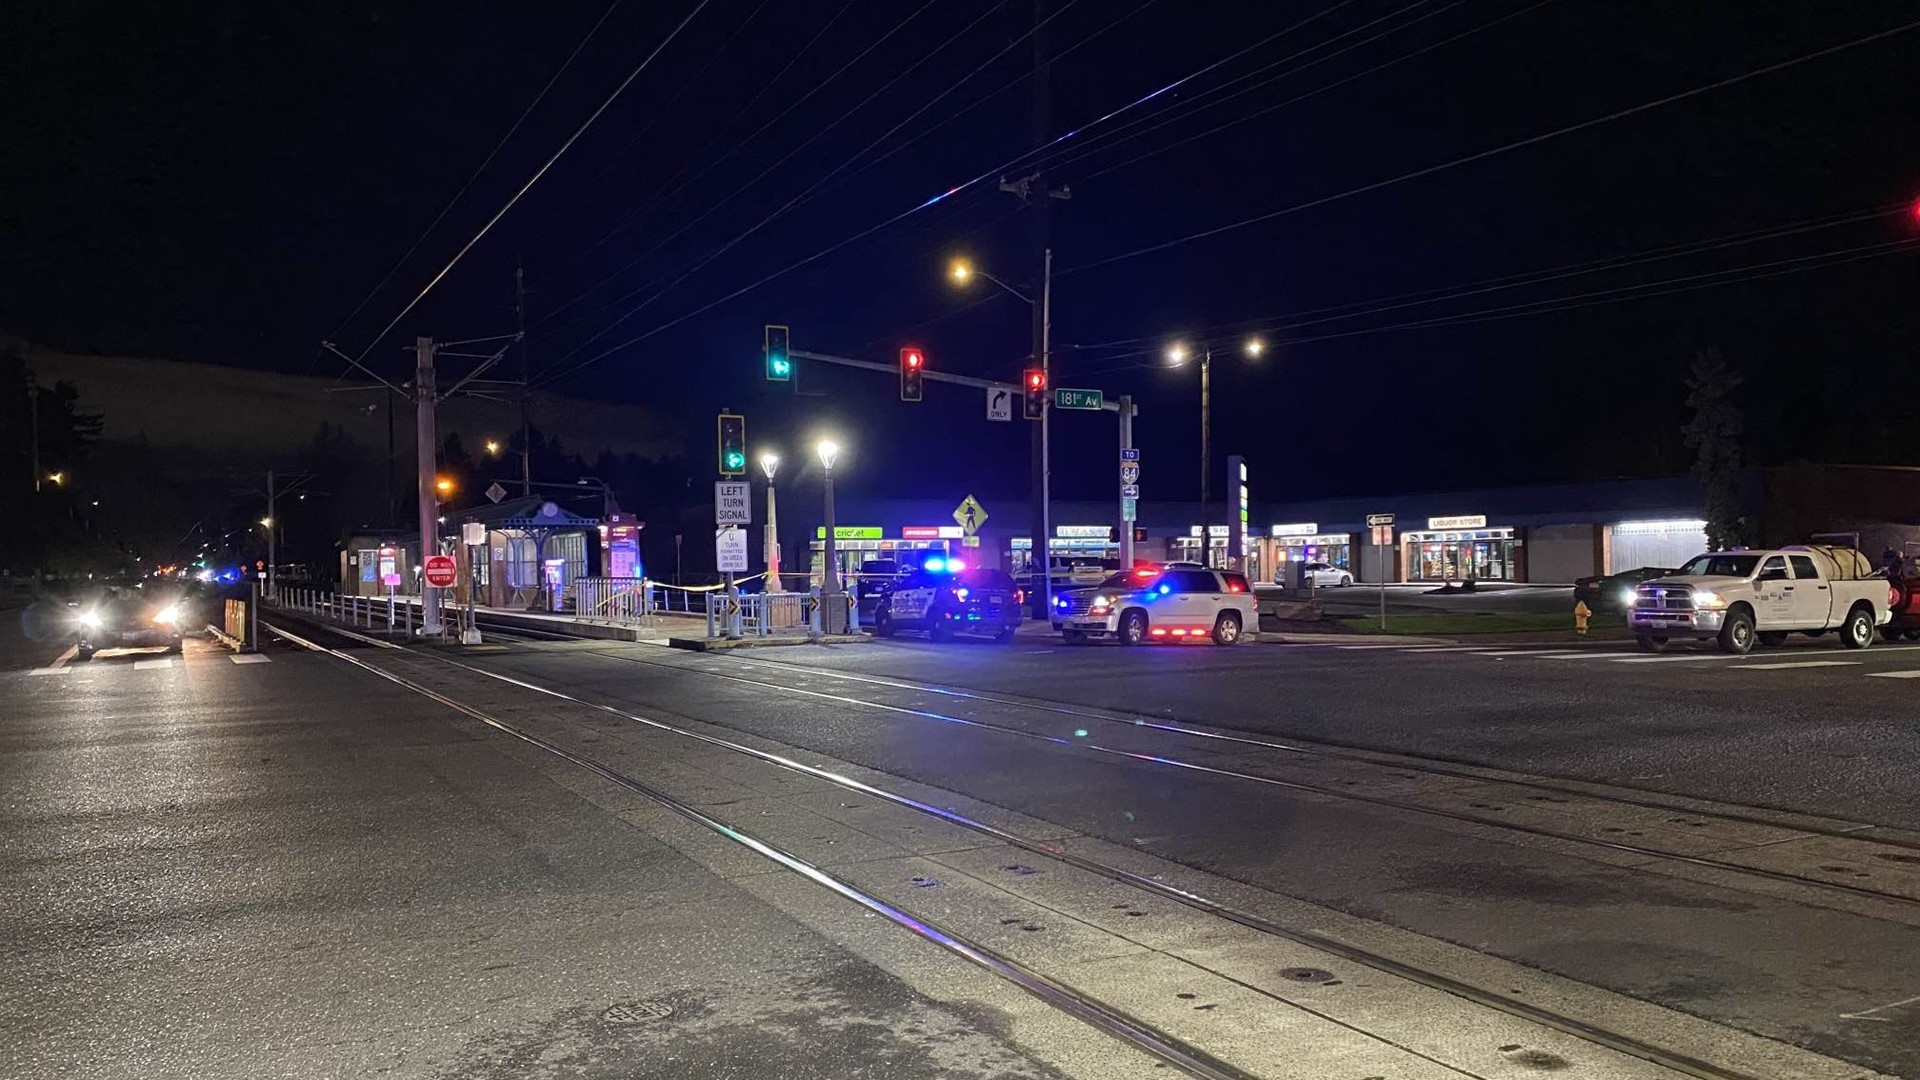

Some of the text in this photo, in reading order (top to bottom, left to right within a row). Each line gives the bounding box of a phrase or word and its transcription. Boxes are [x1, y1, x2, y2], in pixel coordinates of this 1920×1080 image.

[1085, 396, 1097, 406] Av
[1125, 451, 1135, 459] TO
[1124, 467, 1136, 480] 84
[721, 486, 743, 496] LEFT
[723, 498, 744, 508] TURN
[719, 510, 747, 520] SIGNAL
[1460, 518, 1482, 526] STORE
